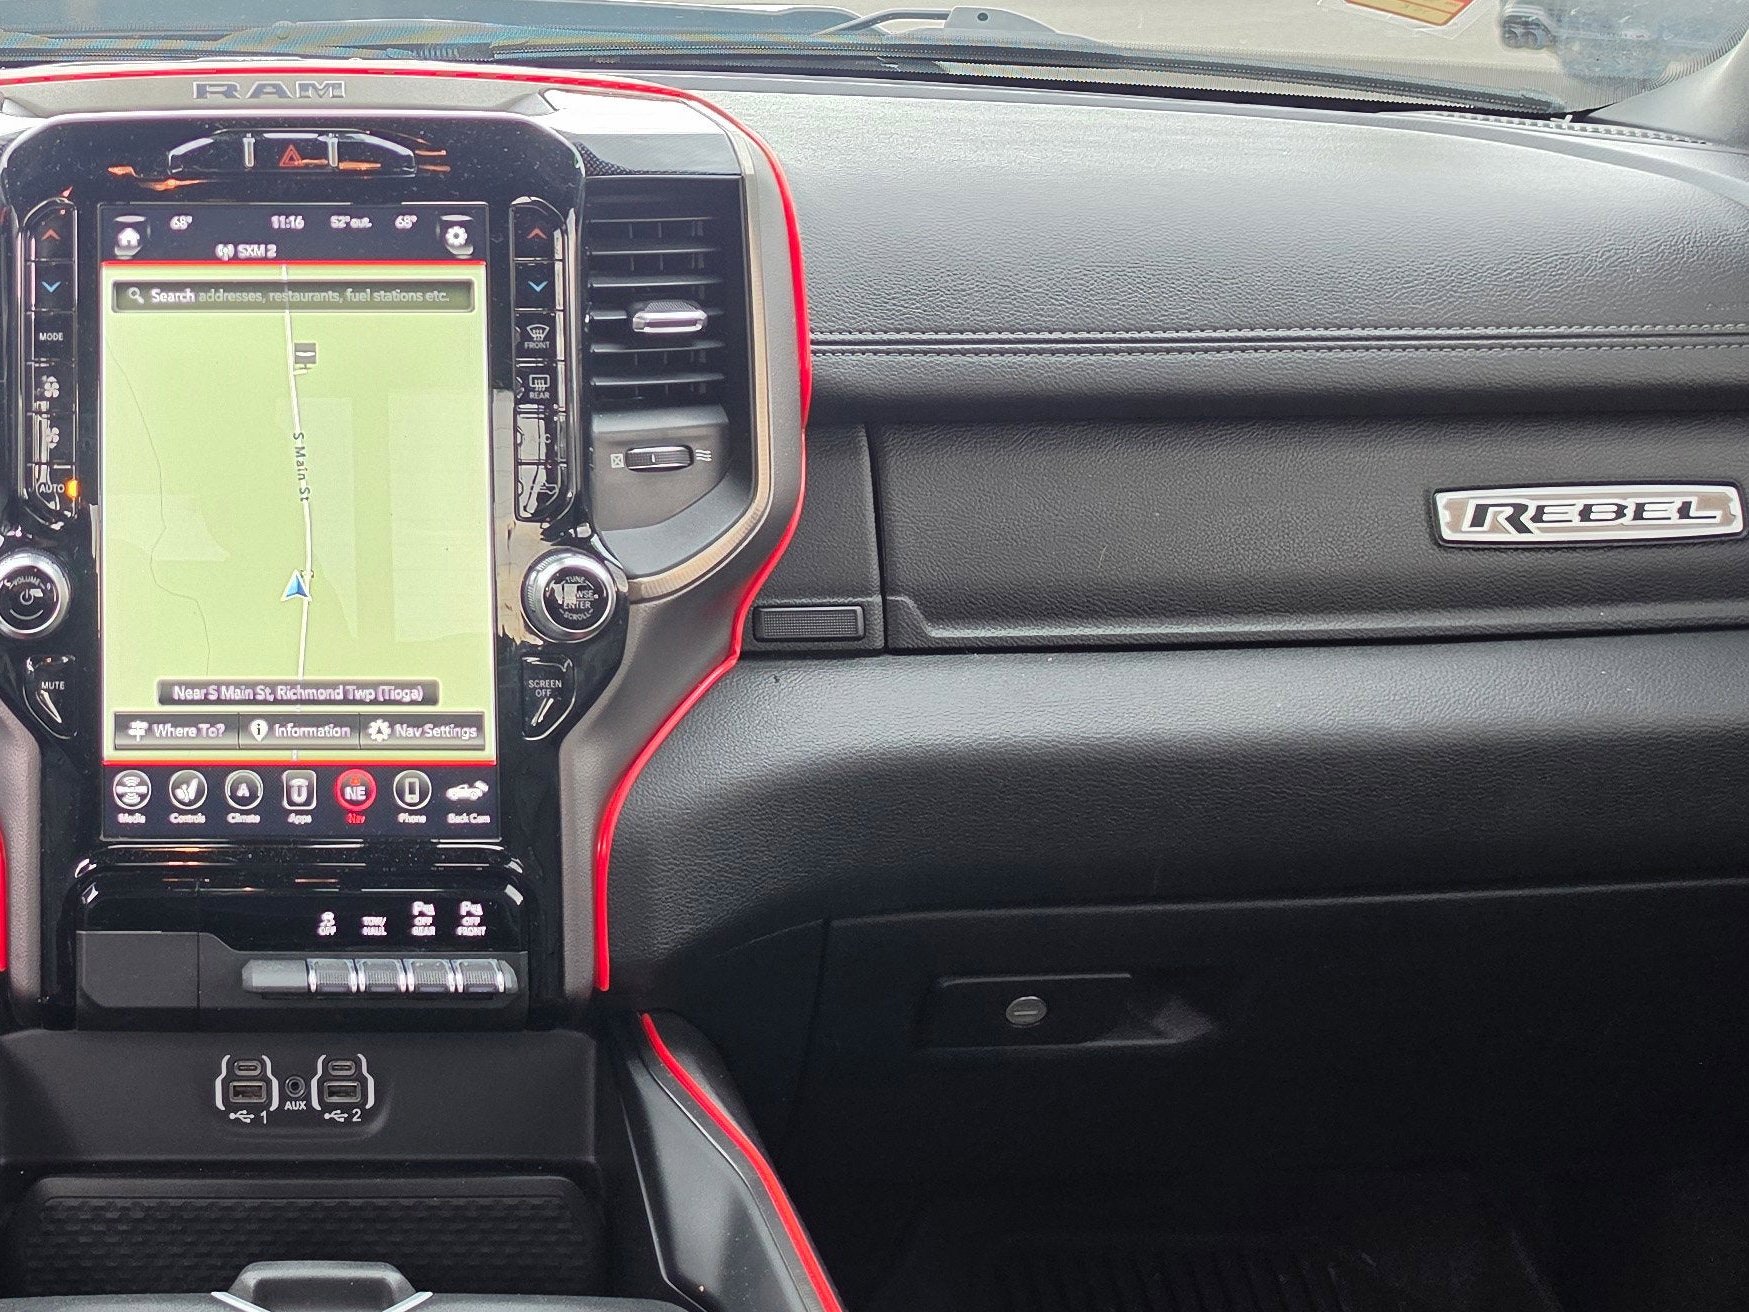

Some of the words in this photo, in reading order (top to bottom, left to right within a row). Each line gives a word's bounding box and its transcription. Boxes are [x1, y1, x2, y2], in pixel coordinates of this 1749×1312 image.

[192, 81, 346, 99] RAM
[271, 215, 305, 229] 11:16
[237, 244, 266, 258] SXM
[266, 244, 277, 258] 2
[151, 289, 196, 303] Search
[199, 289, 266, 303] addresses,
[269, 290, 344, 303] restaurants,
[346, 288, 371, 302] fuel
[373, 289, 423, 302] stations
[425, 290, 450, 302] etc.
[39, 332, 64, 341] MODE
[524, 341, 550, 349] FRONT
[529, 391, 550, 399] REAR
[293, 432, 305, 440] S
[294, 446, 308, 481] Main
[39, 483, 65, 493] AUTO
[299, 486, 311, 502] St
[1461, 497, 1723, 535] REBEL
[14, 575, 41, 586] VOLUME
[565, 575, 586, 584] TUNE
[564, 601, 591, 609] ENTER
[563, 610, 591, 621] SCROLL
[42, 681, 65, 690] MUTE
[528, 679, 562, 688] SCREEN
[173, 685, 206, 700] Near
[207, 686, 218, 700] S
[219, 685, 254, 700] Main
[255, 685, 274, 702] St,
[277, 685, 344, 700] Richmond
[347, 685, 375, 703] Twp
[376, 685, 424, 703] (Tioga)
[535, 689, 552, 697] OFF
[152, 723, 197, 738] Where
[198, 723, 226, 738] To?
[274, 723, 351, 738] Information
[395, 723, 423, 738] Nav
[424, 723, 478, 740] Settings
[344, 786, 367, 801] NE
[398, 813, 426, 824] Phone
[284, 1100, 307, 1110] AUX
[260, 1110, 267, 1124] 1
[352, 1109, 362, 1122] 2
